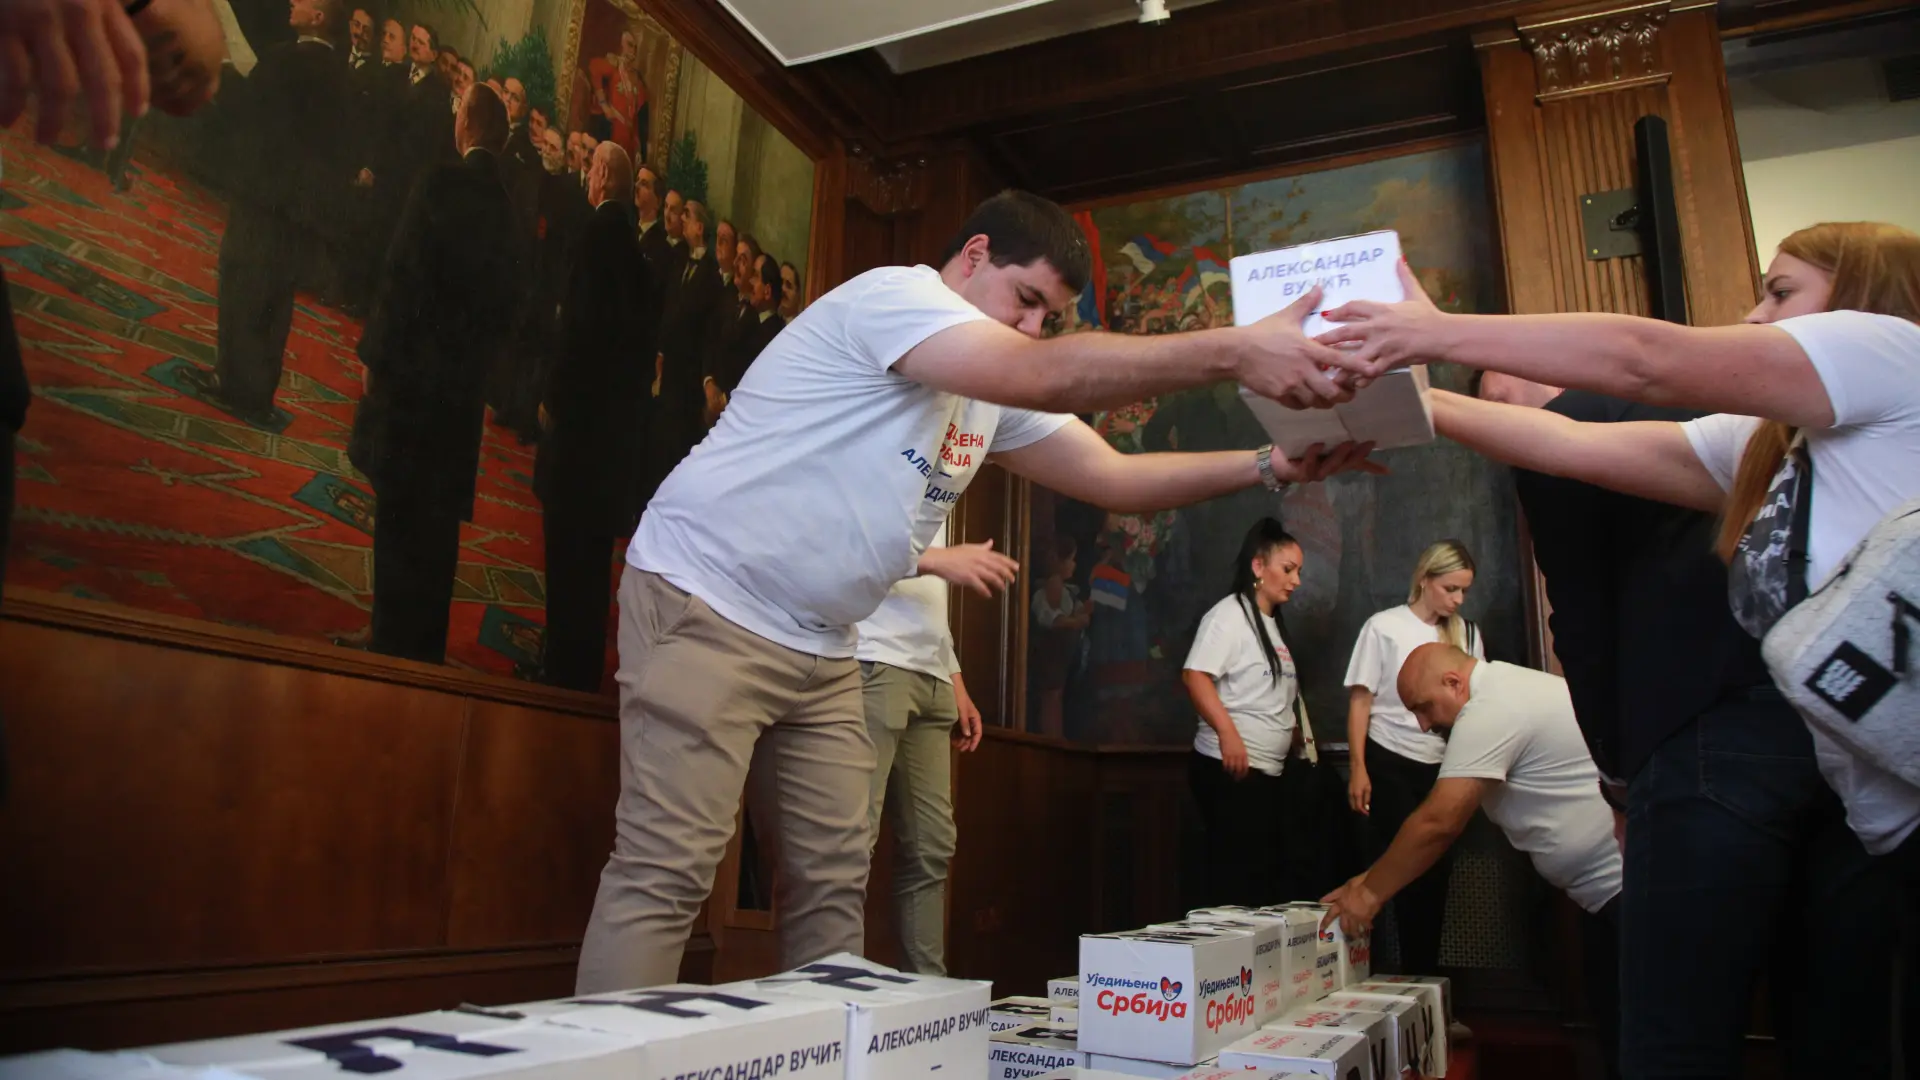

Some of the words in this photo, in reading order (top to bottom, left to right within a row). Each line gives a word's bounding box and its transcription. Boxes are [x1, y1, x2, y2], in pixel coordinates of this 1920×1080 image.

[1247, 247, 1384, 282] АЛЕКСАНДАР
[1086, 972, 1158, 990] Уједињена
[1199, 974, 1240, 999] Уједињена
[1097, 990, 1187, 1022] Србија
[1206, 992, 1255, 1034] Србија
[867, 1016, 956, 1055] АЛЕКСАНДАР
[790, 1041, 842, 1072] ВУЧИЋ
[988, 1049, 1075, 1069] ЛЕКСАНДАР
